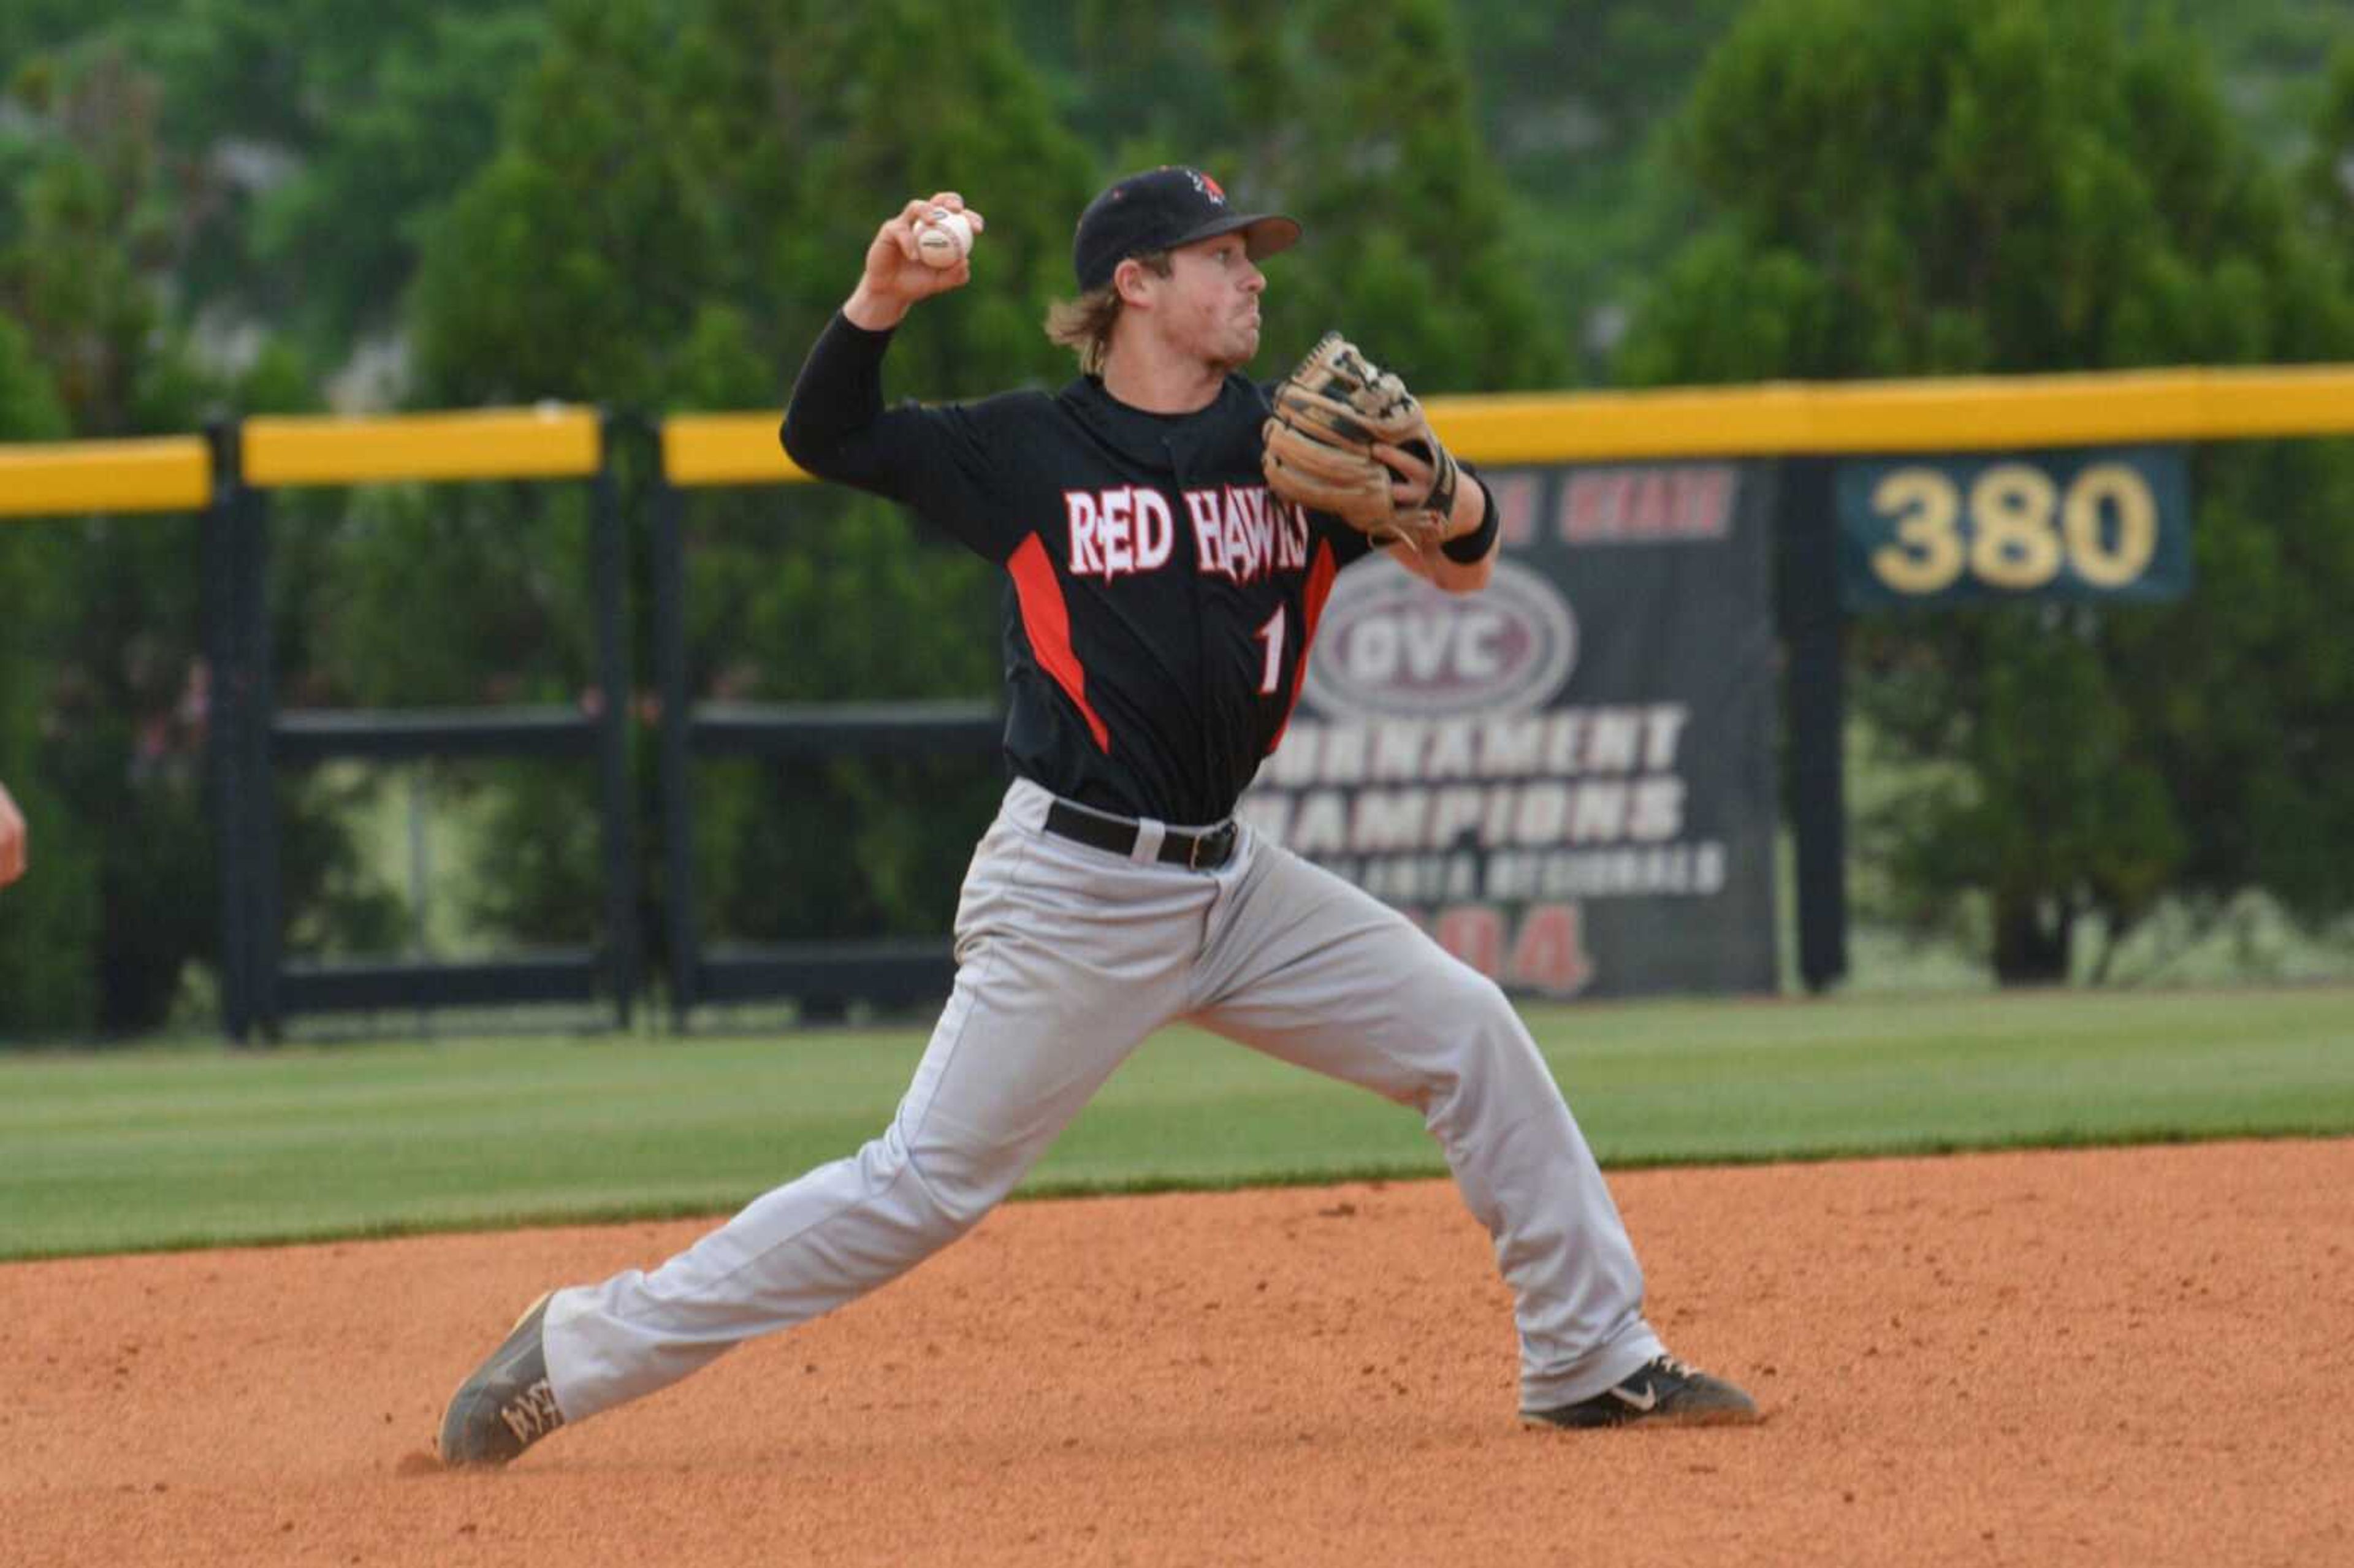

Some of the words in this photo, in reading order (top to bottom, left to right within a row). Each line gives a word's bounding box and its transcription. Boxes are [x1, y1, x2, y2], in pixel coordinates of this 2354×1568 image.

[1065, 485, 1174, 584] RED
[1871, 461, 2159, 595] 380
[1258, 603, 1286, 696] 1
[1352, 613, 1502, 682] OVC
[1258, 702, 1686, 788] URNAMENT
[1411, 900, 1590, 998] 04
